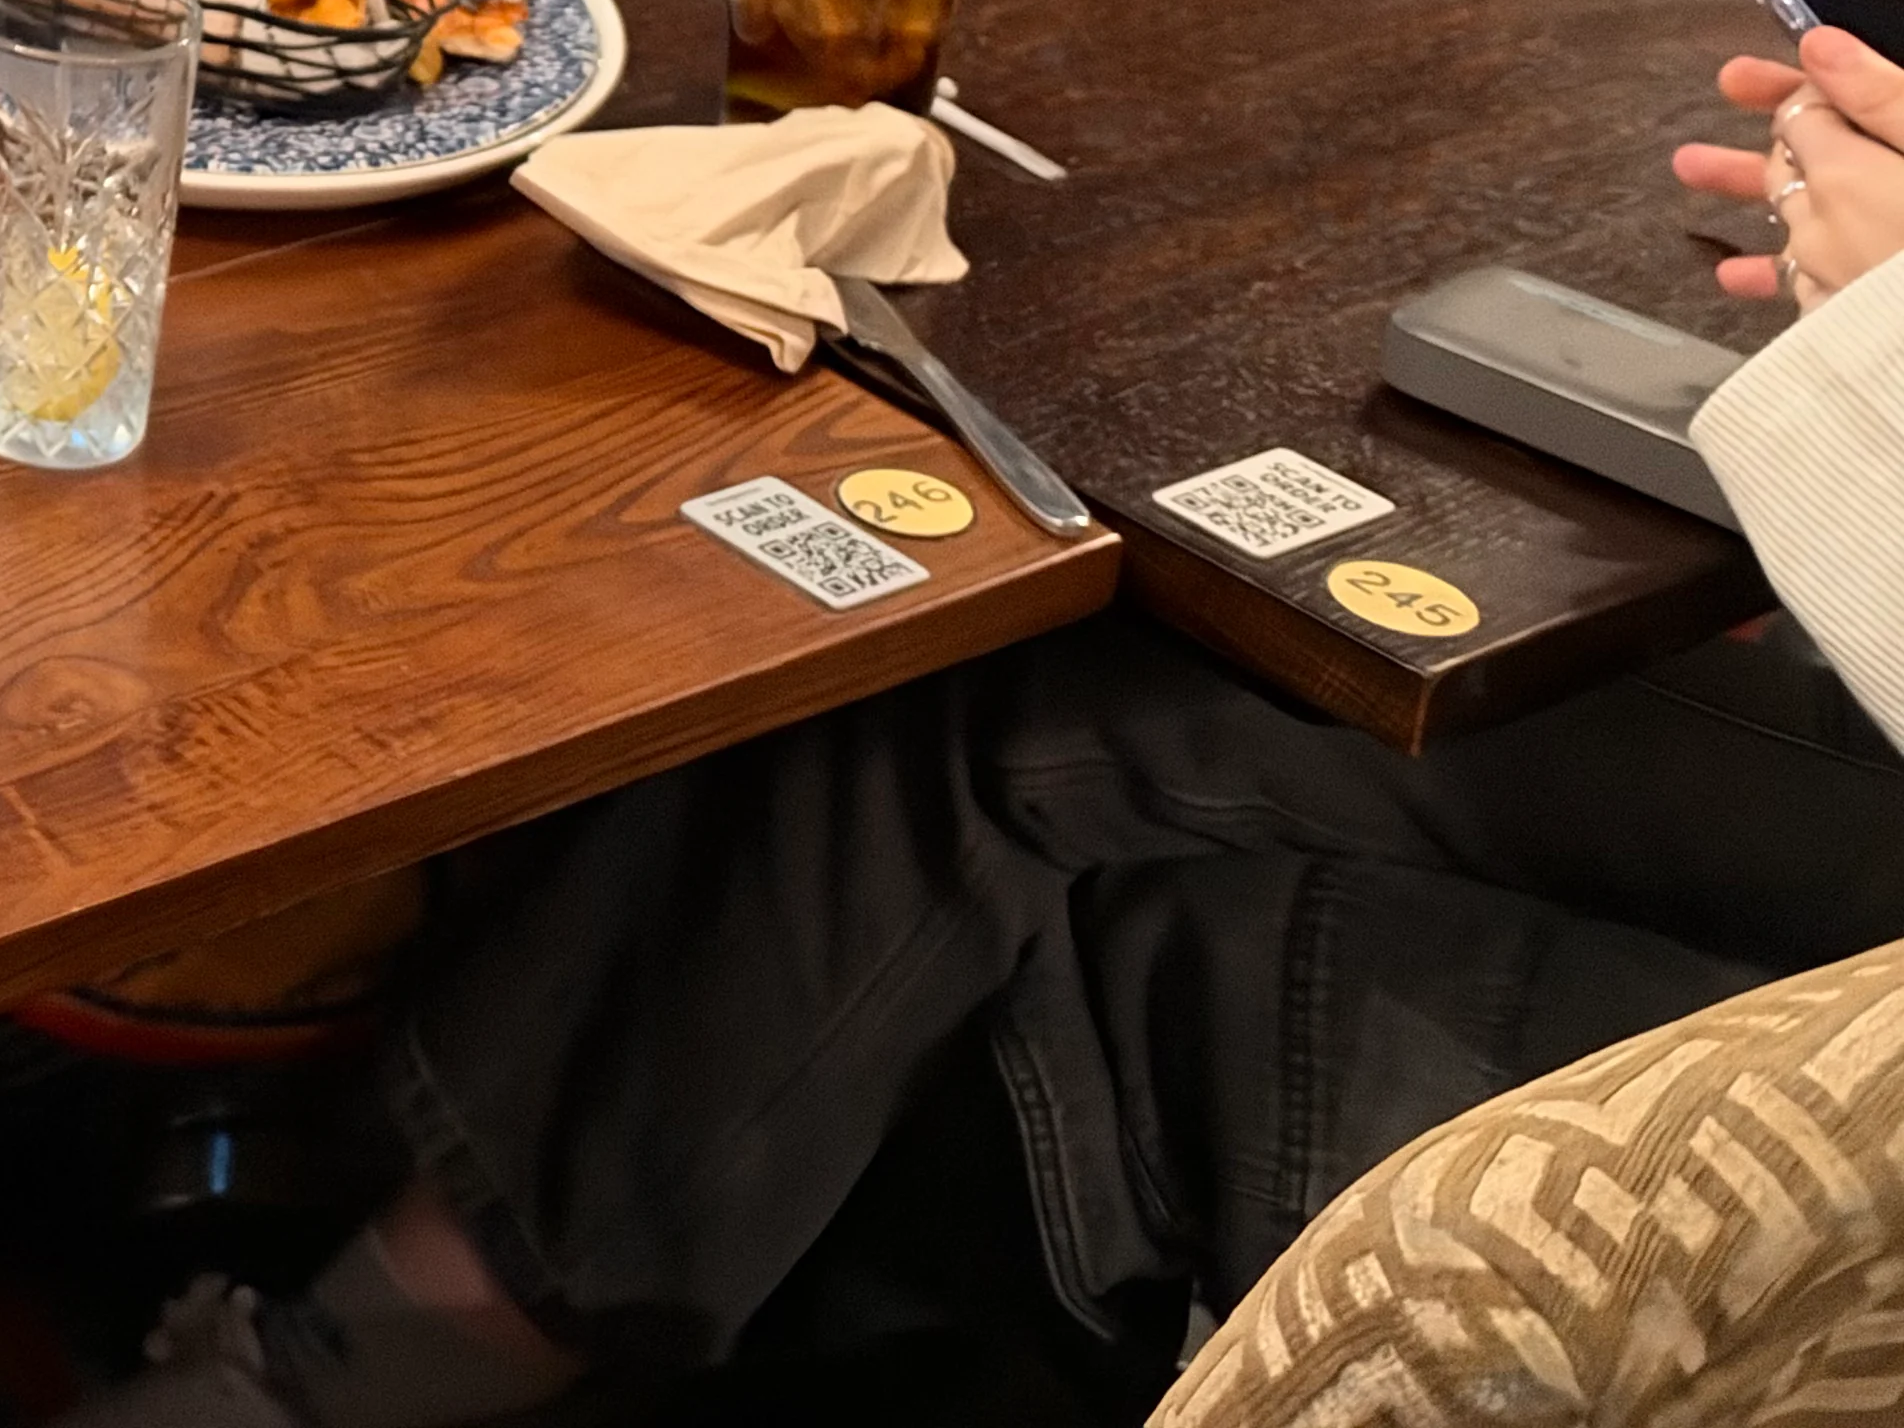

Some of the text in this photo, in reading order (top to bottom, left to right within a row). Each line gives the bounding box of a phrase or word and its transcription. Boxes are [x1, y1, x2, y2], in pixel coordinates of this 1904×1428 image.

[852, 480, 953, 524] 246
[1259, 473, 1337, 513] ORDER
[1267, 461, 1328, 495] SCAN
[1330, 492, 1362, 512] TO
[713, 498, 765, 527] SCAN
[764, 492, 797, 513] TO
[742, 510, 813, 537] ORDER
[1345, 569, 1462, 628] 245
